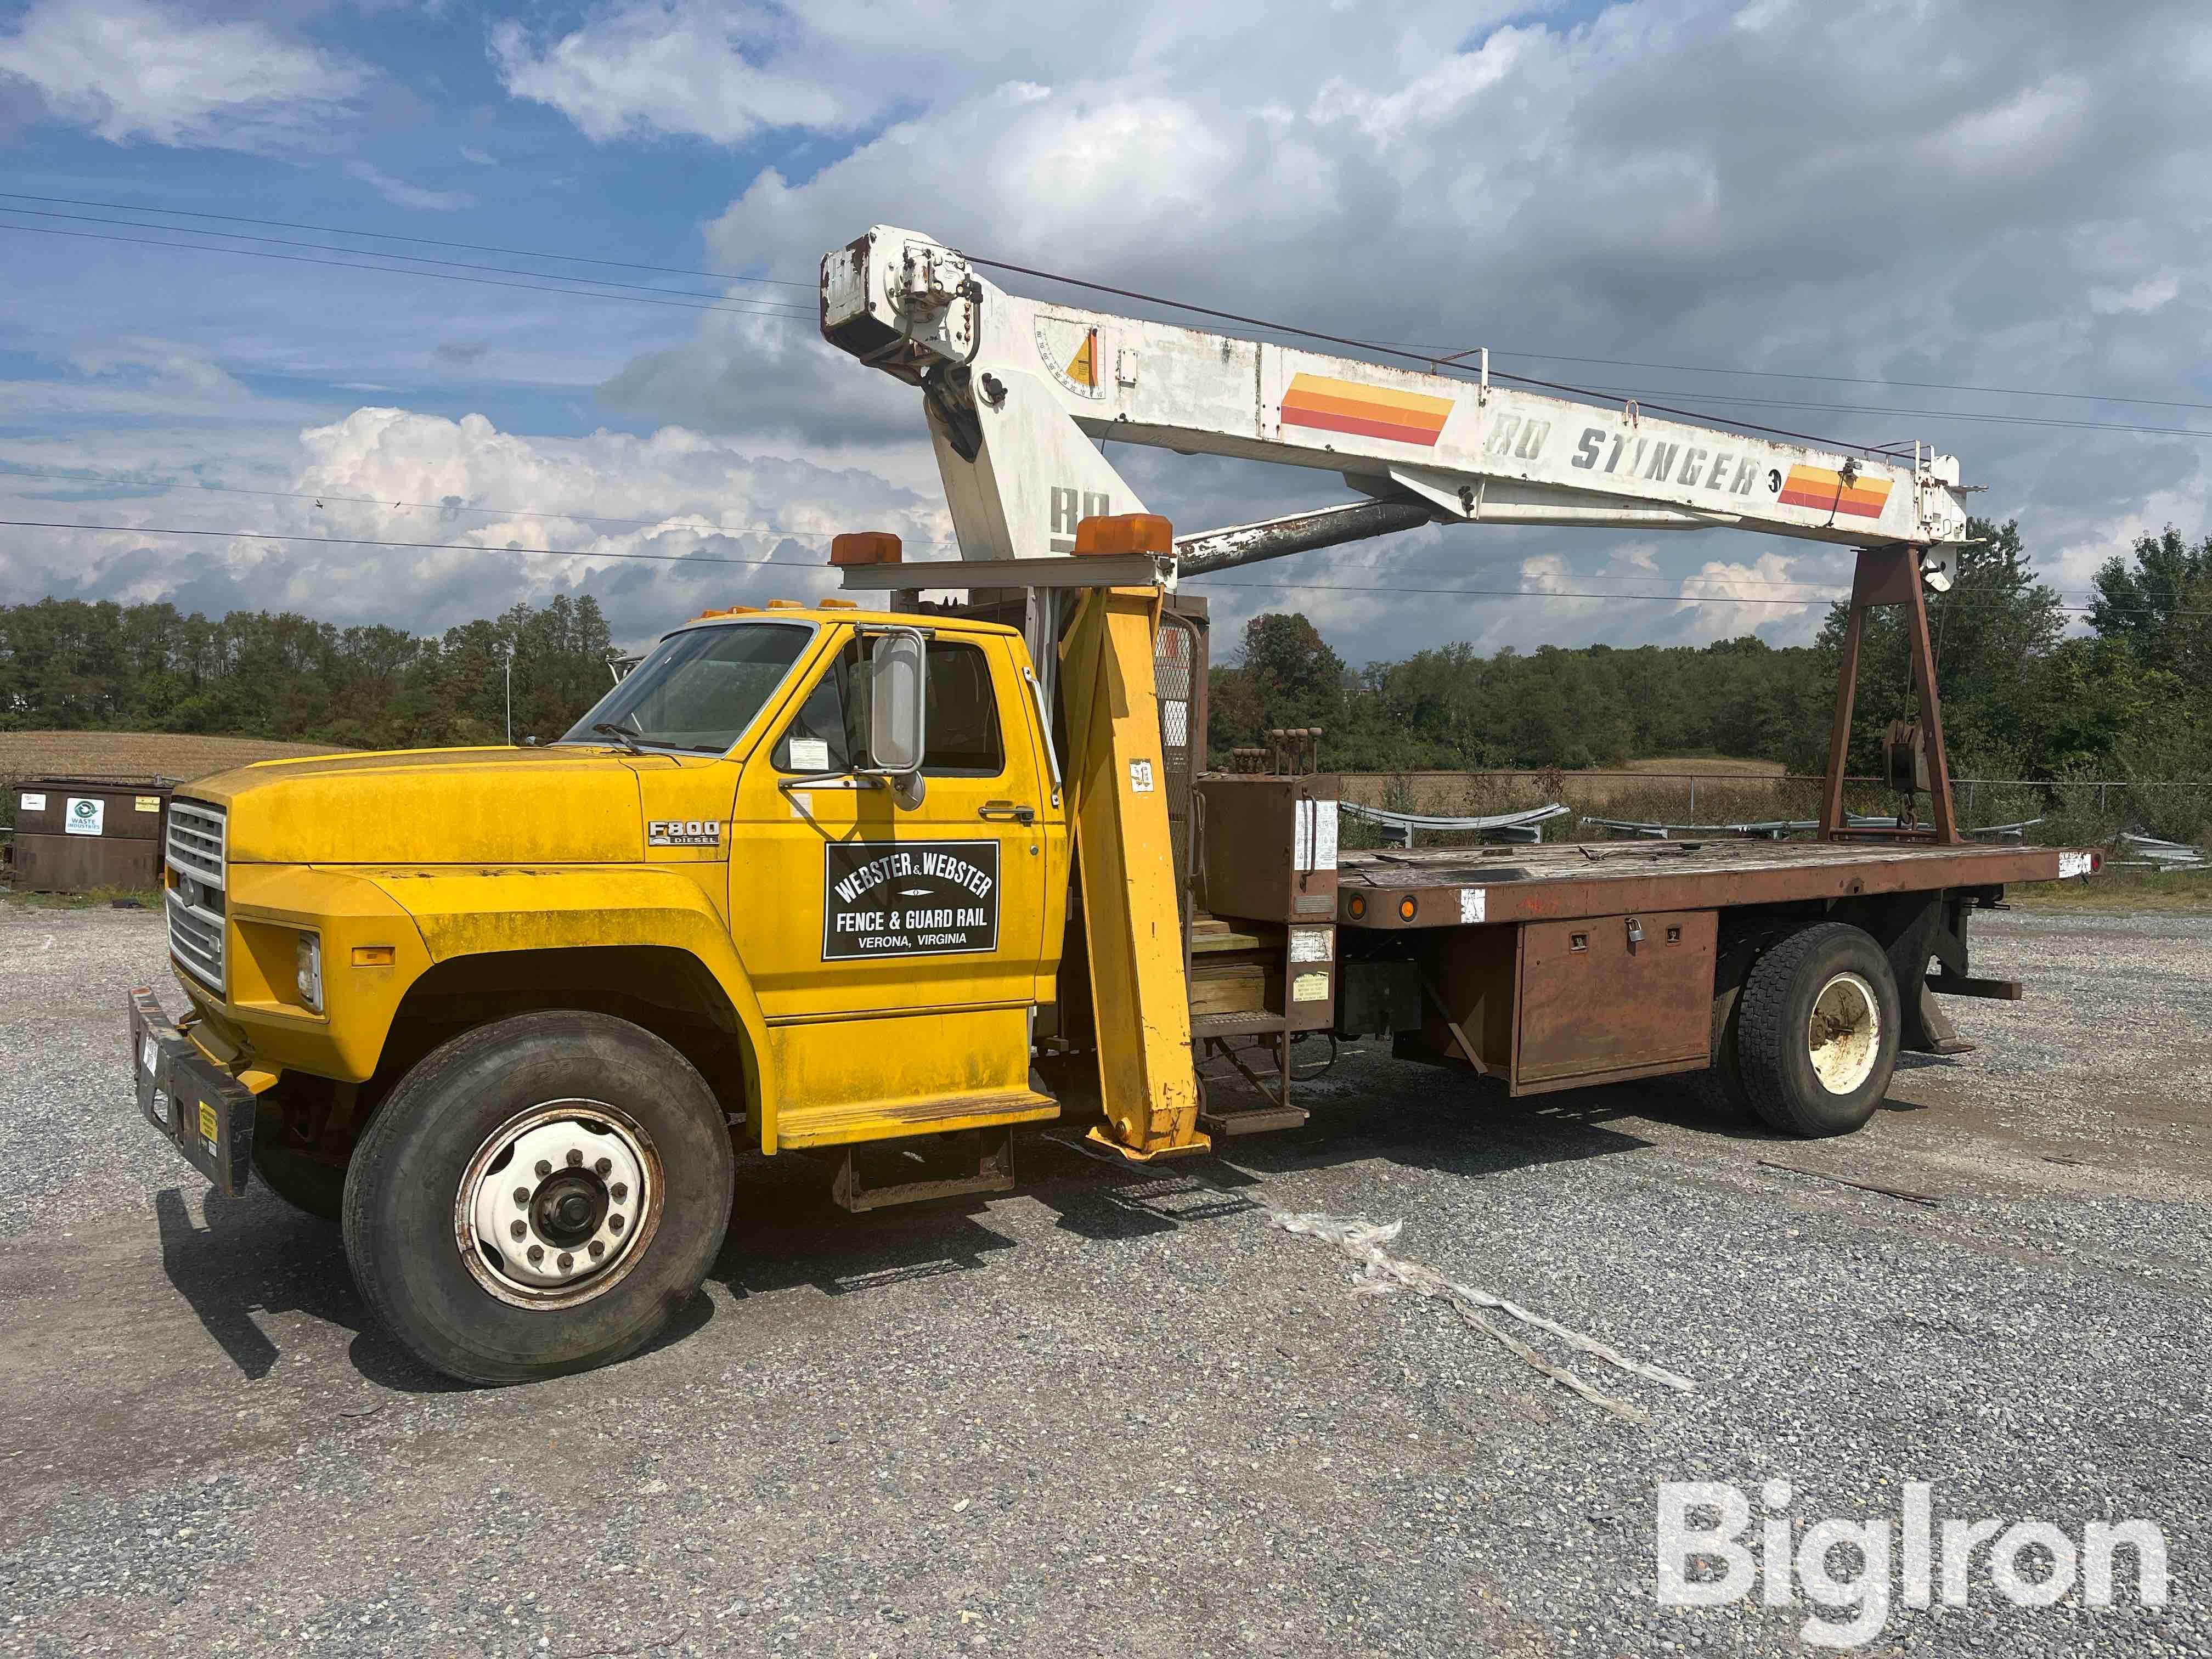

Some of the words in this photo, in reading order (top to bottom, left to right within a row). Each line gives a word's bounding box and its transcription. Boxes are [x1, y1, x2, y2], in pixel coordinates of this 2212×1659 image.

[1571, 427, 1759, 495] STINGER
[649, 821, 720, 836] F800
[834, 853, 912, 904] WEBSTER
[913, 865, 922, 876] &
[923, 852, 992, 899] WEBSTER
[837, 912, 884, 932] FENCE
[889, 911, 900, 930] &
[906, 909, 952, 929] GUARD
[957, 908, 987, 927] RAIL
[859, 935, 911, 949] VERONA,
[917, 933, 967, 945] VIRGINIA
